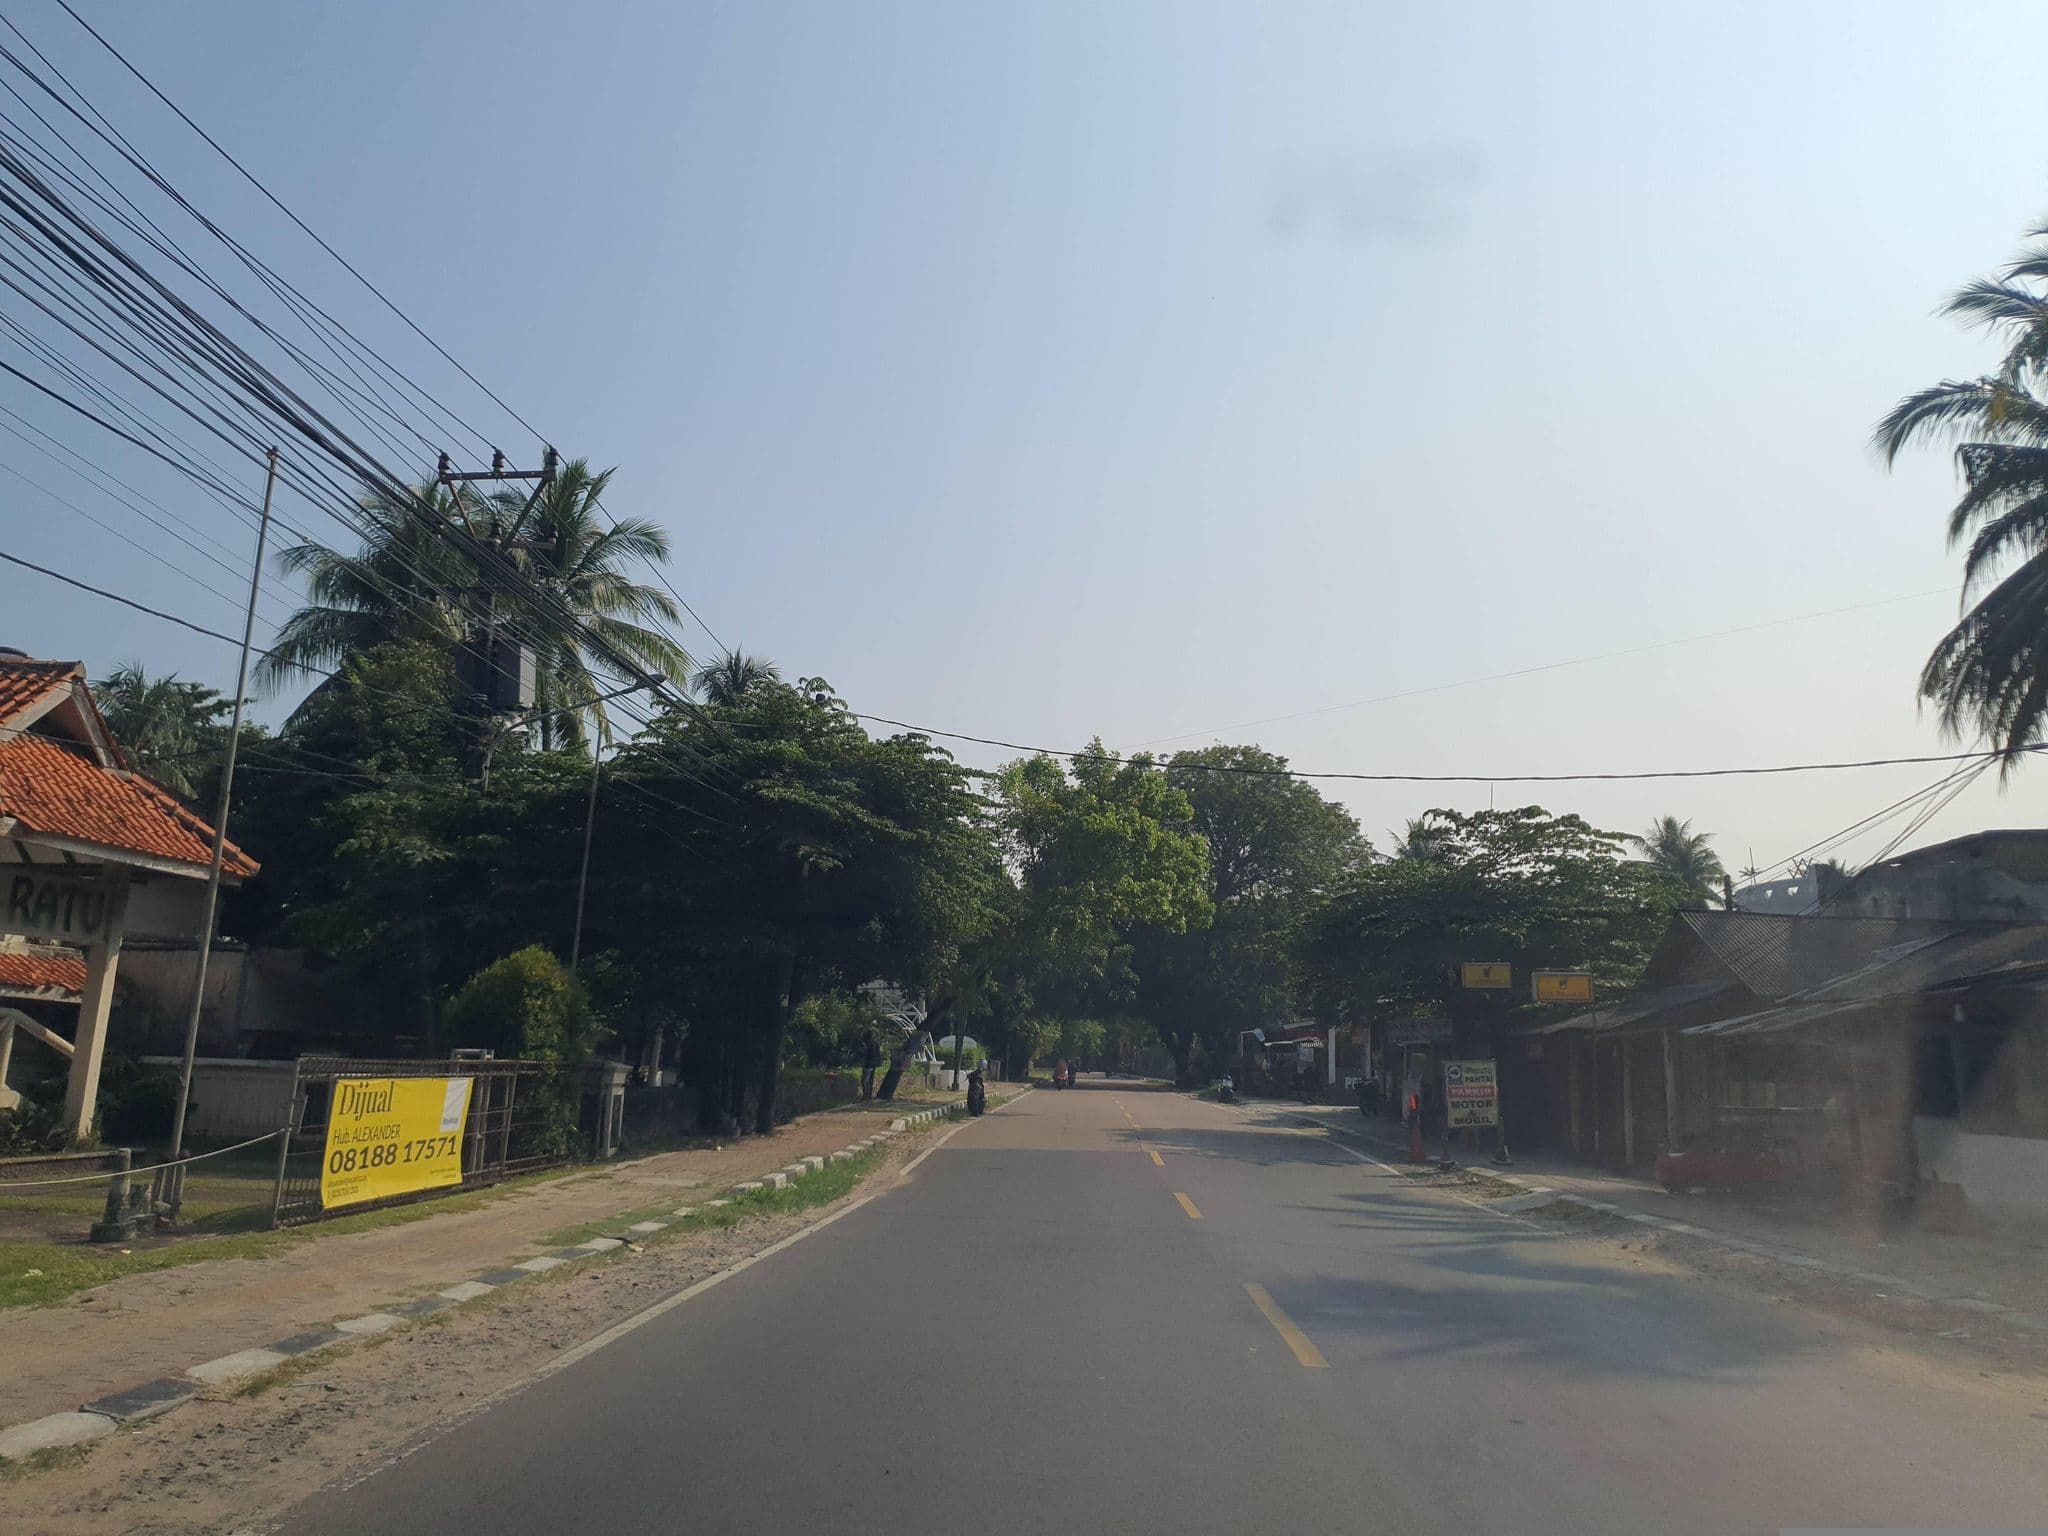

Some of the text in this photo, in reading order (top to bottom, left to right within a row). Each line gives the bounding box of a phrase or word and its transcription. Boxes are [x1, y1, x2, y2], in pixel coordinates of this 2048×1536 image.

[1451, 1087, 1493, 1097] PARKIR
[338, 1080, 395, 1121] Dijual
[1451, 1100, 1493, 1109] MOTOR
[1455, 1116, 1493, 1125] MOBIL
[351, 1124, 401, 1143] ALEXANDER
[329, 1135, 457, 1175] 08188 17571
